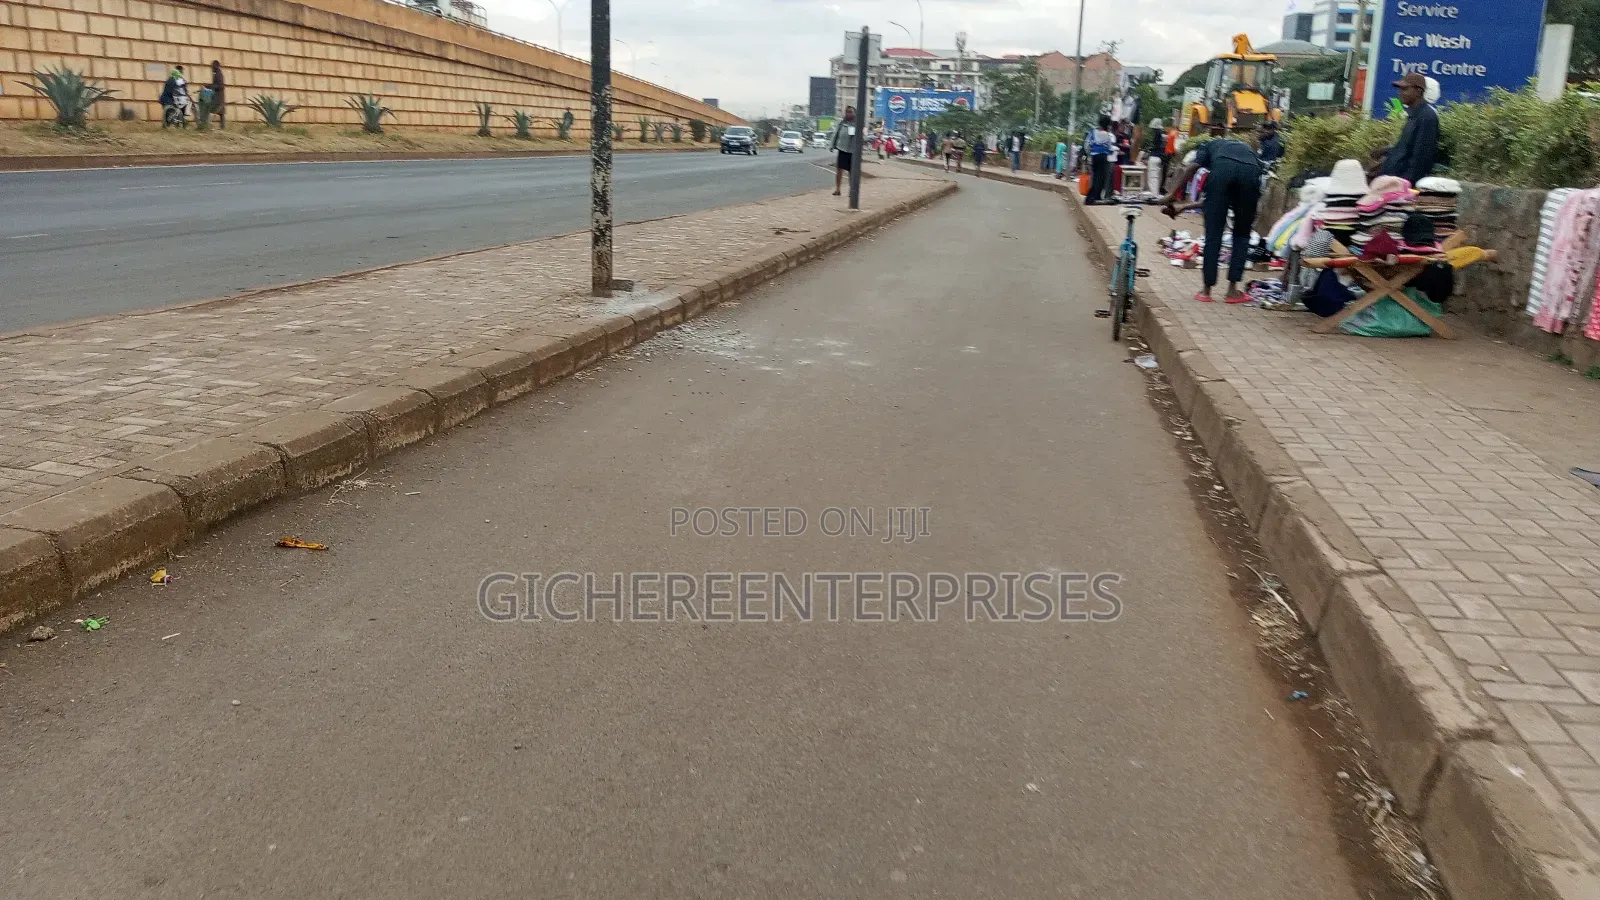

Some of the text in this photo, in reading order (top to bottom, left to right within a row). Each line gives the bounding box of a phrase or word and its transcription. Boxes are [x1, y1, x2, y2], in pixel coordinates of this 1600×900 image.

[1397, 1, 1458, 19] Service
[1393, 31, 1471, 49] Car Wash
[1391, 58, 1486, 76] Tyre Centre
